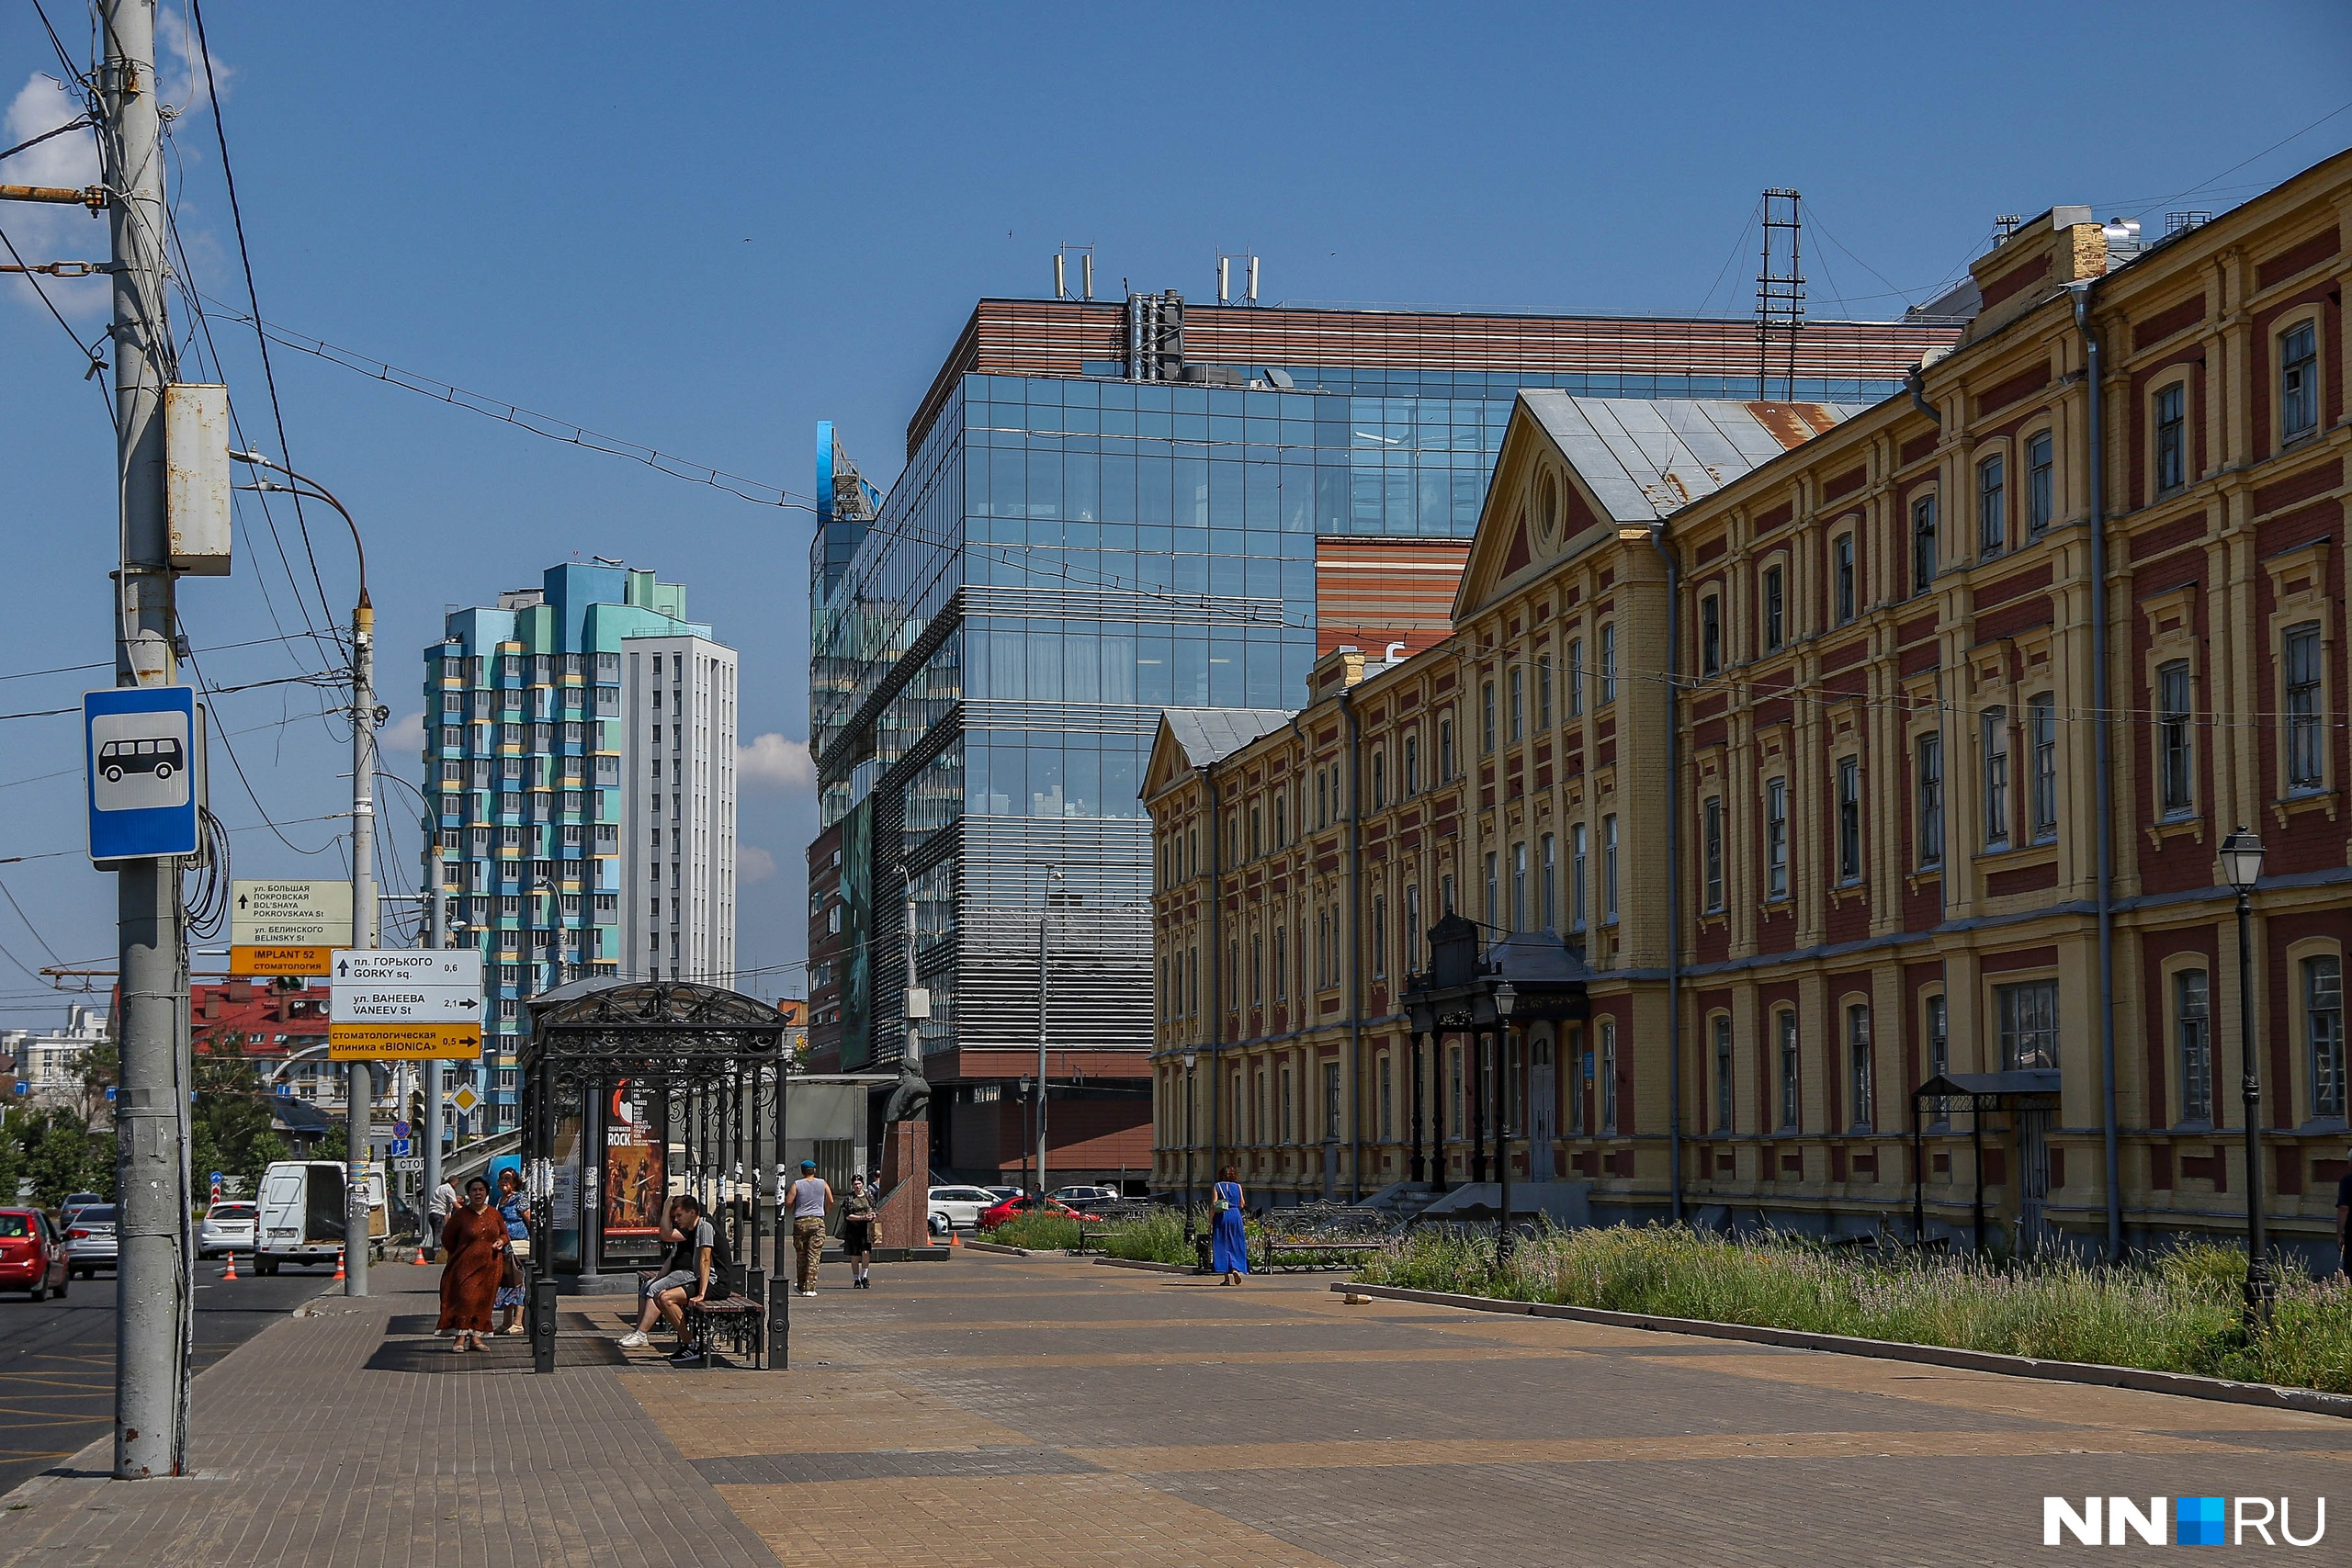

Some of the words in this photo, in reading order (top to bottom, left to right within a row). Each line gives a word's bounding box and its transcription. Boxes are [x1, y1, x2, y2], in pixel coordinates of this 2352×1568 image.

[254, 951, 300, 959] IMPLANT
[302, 951, 314, 959] 52
[372, 957, 433, 966] ГОРЬКОГО
[444, 964, 458, 973] 0,6
[354, 969, 394, 978] GORKY
[396, 971, 412, 980] sq.
[353, 996, 369, 1004] ул.
[372, 994, 425, 1003] ВАНЕЕВА
[444, 999, 458, 1009] 2,1
[353, 1006, 398, 1015] VANEEV
[400, 1005, 412, 1015] St
[443, 1037, 457, 1046] 0,5
[379, 1042, 436, 1052] «BIONICA»
[607, 1133, 631, 1146] ROCK
